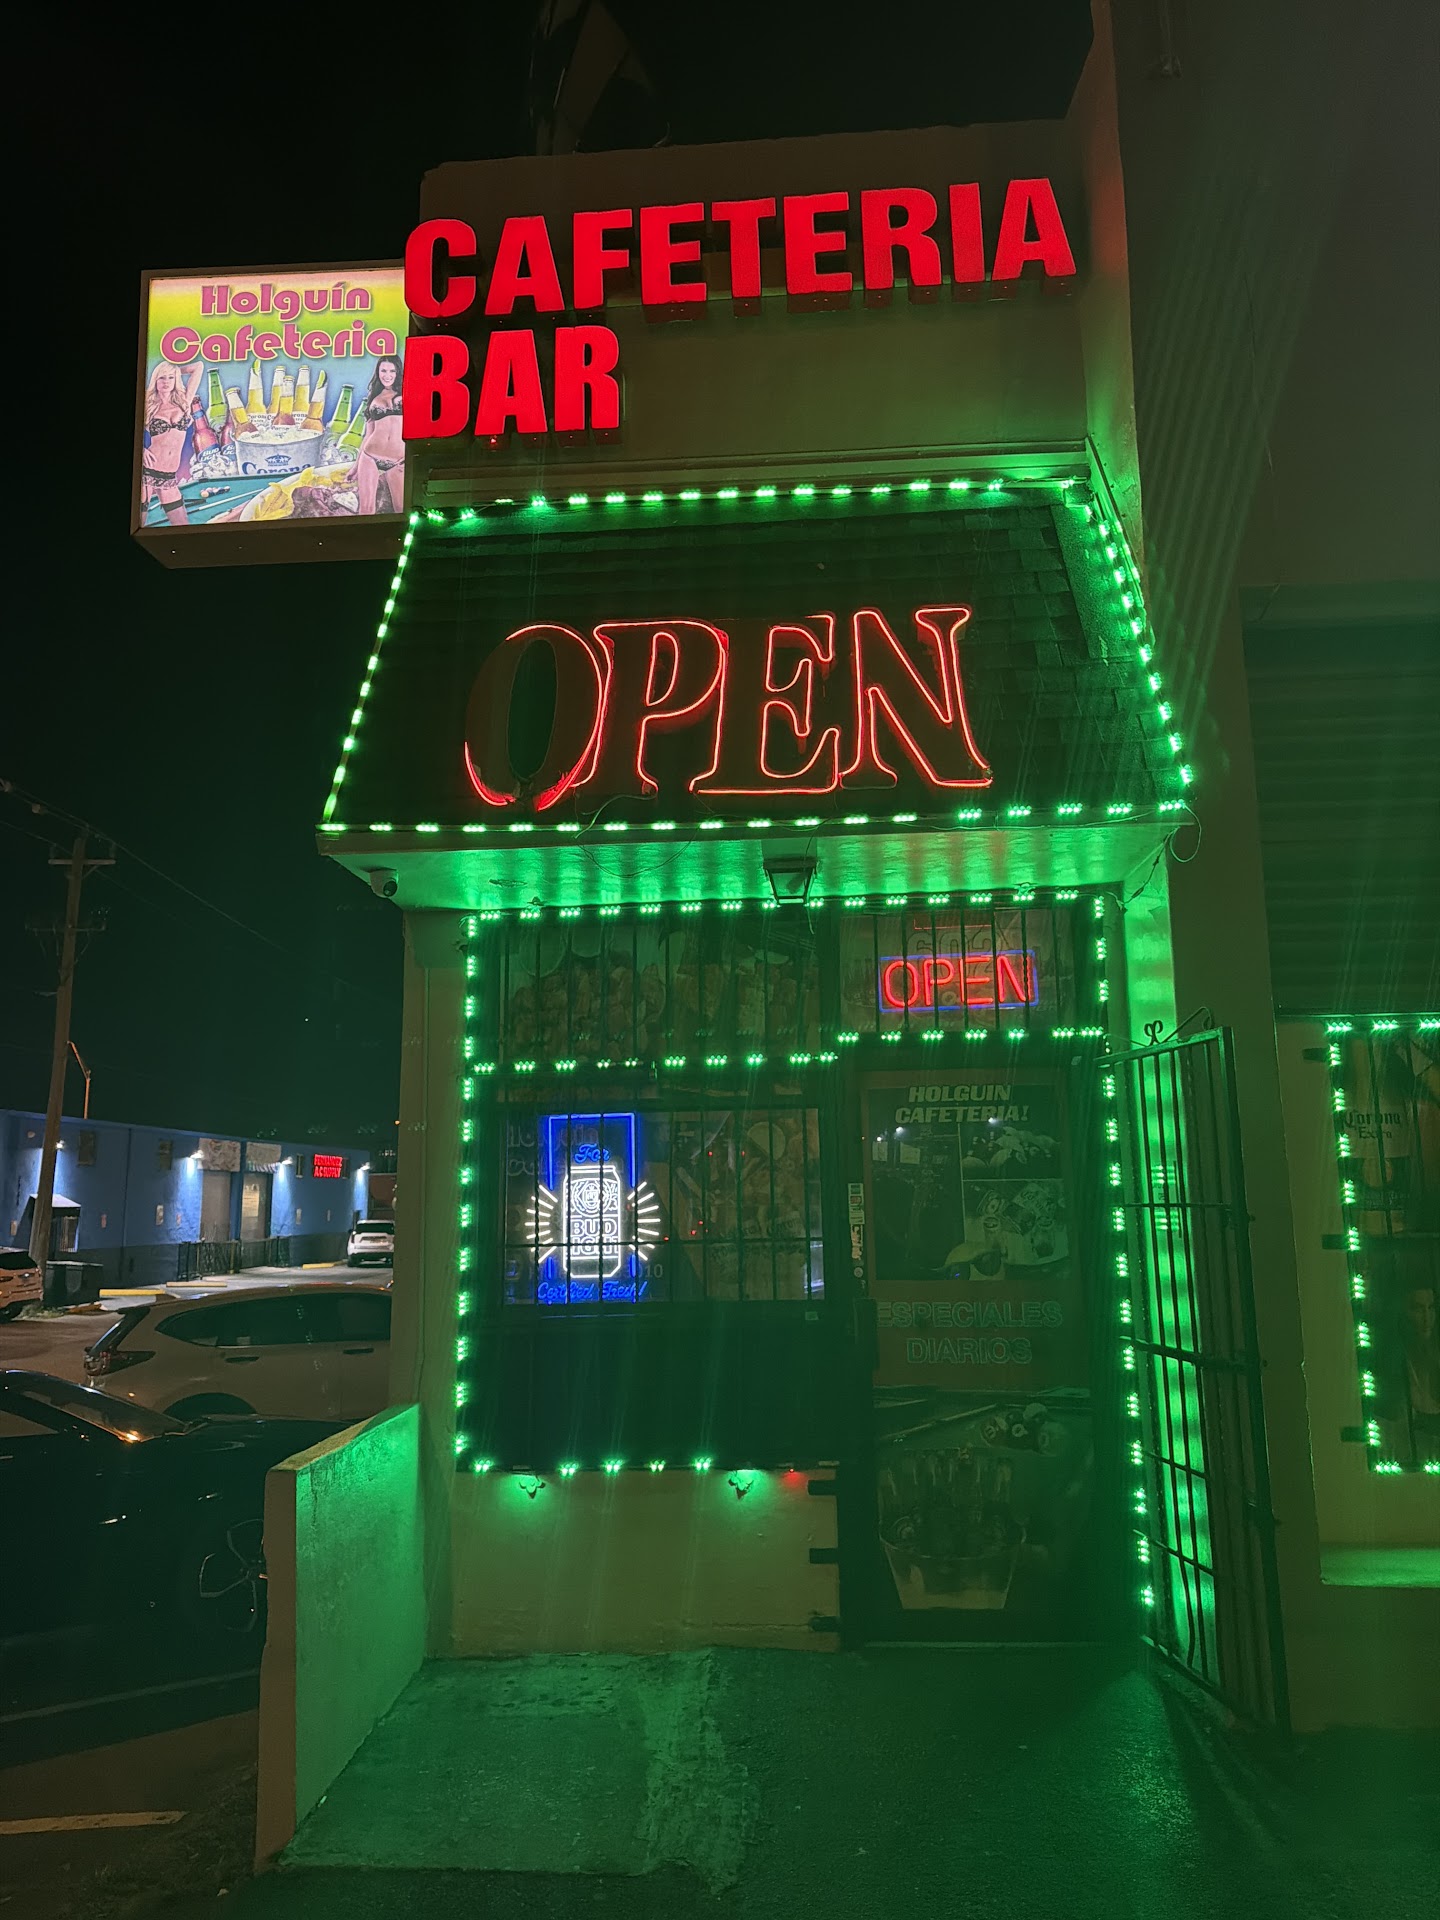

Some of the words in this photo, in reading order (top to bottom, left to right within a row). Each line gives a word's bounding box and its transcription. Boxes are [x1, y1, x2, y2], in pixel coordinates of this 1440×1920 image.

[403, 178, 1077, 319] CAFETERIA
[200, 281, 371, 321] Holguín
[160, 320, 397, 364] Cafeteria
[401, 326, 620, 440] BAR
[463, 603, 993, 811] OPEN
[885, 954, 1033, 1008] OPEN
[908, 1084, 1012, 1103] HOLGUIN
[895, 1105, 1029, 1124] CAFETERIA!
[574, 1143, 610, 1164] For
[568, 1217, 618, 1238] BUD
[566, 1236, 619, 1256] IGHT
[876, 1301, 1064, 1329] ESPECIALES
[906, 1337, 1033, 1365] DIARIOS
